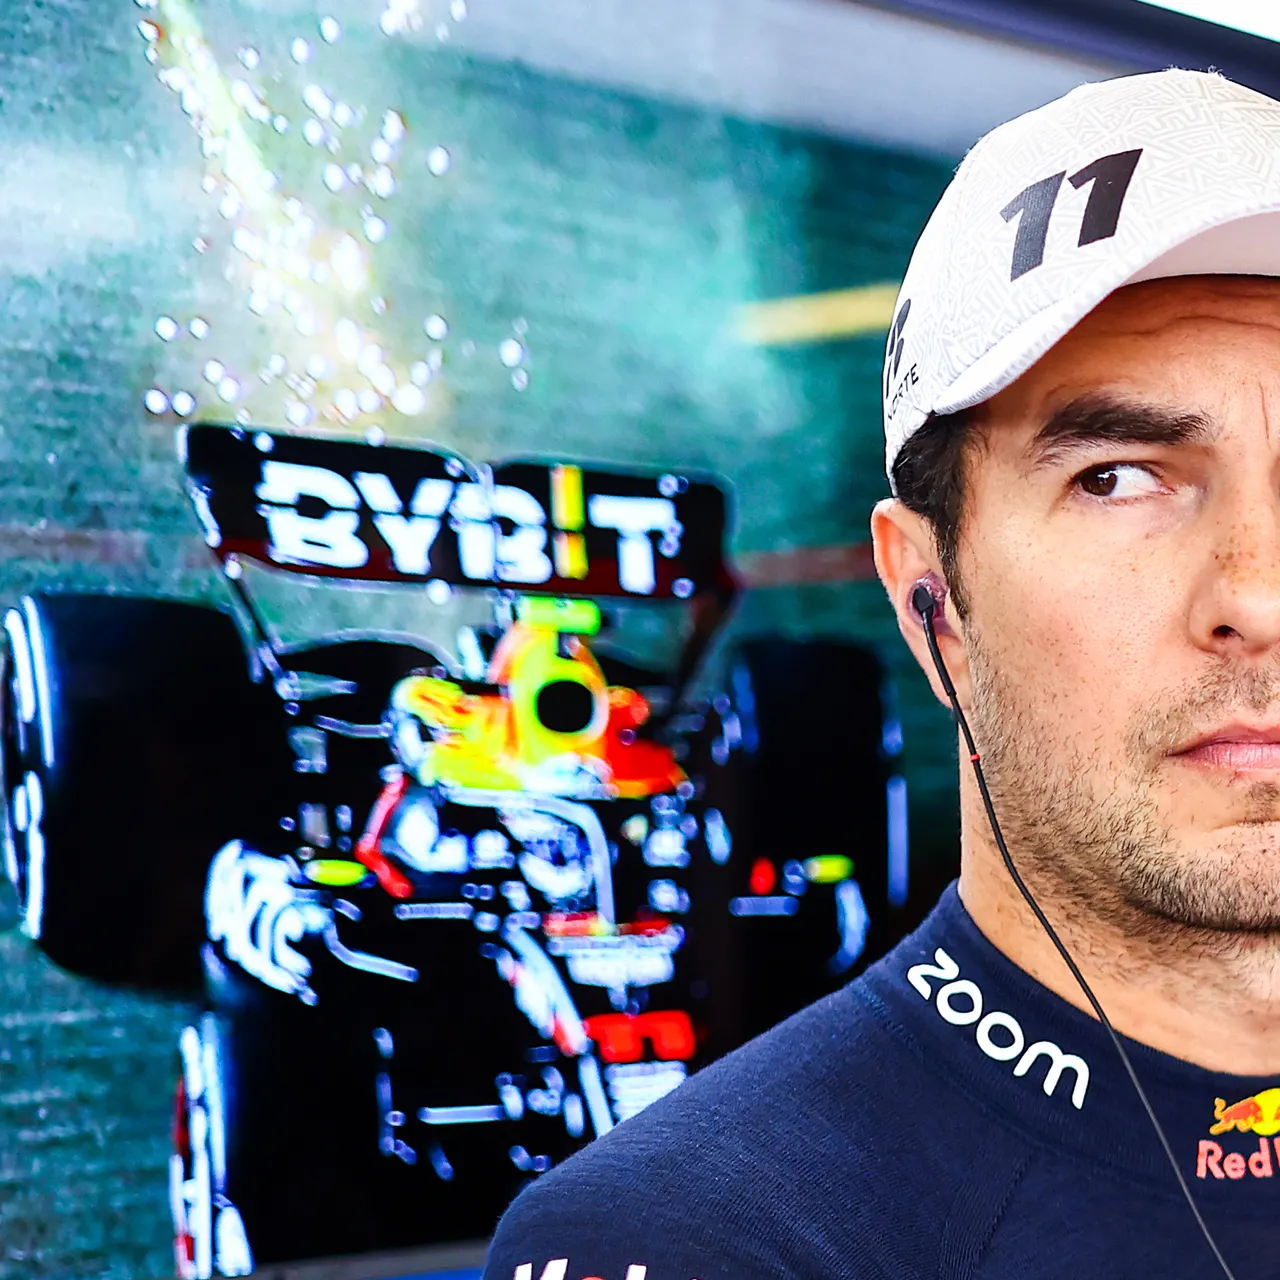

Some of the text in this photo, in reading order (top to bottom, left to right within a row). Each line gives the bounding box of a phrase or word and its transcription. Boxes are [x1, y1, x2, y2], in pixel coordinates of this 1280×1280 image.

[1000, 147, 1143, 282] 11
[255, 459, 680, 596] BYBIT
[907, 946, 1091, 1110] zoom
[1196, 1137, 1274, 1180] Red
